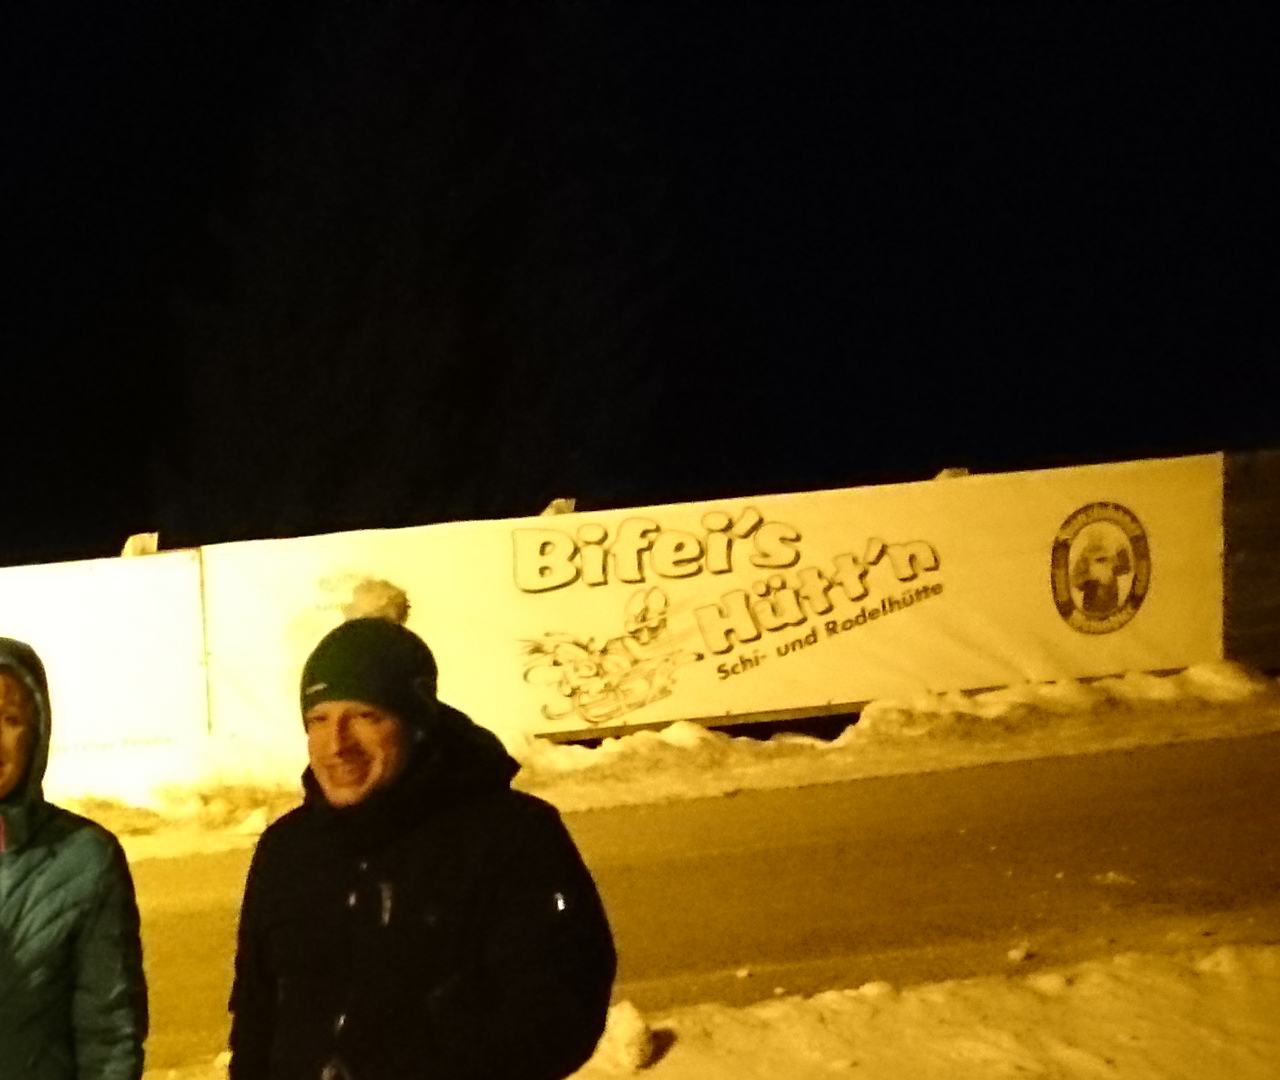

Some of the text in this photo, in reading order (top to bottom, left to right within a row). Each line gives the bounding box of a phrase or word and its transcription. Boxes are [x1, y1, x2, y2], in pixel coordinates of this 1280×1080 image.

[511, 507, 803, 594] Bifei's
[695, 538, 941, 655] Hütt'n
[716, 582, 944, 680] Schi- und Rodelhütte
